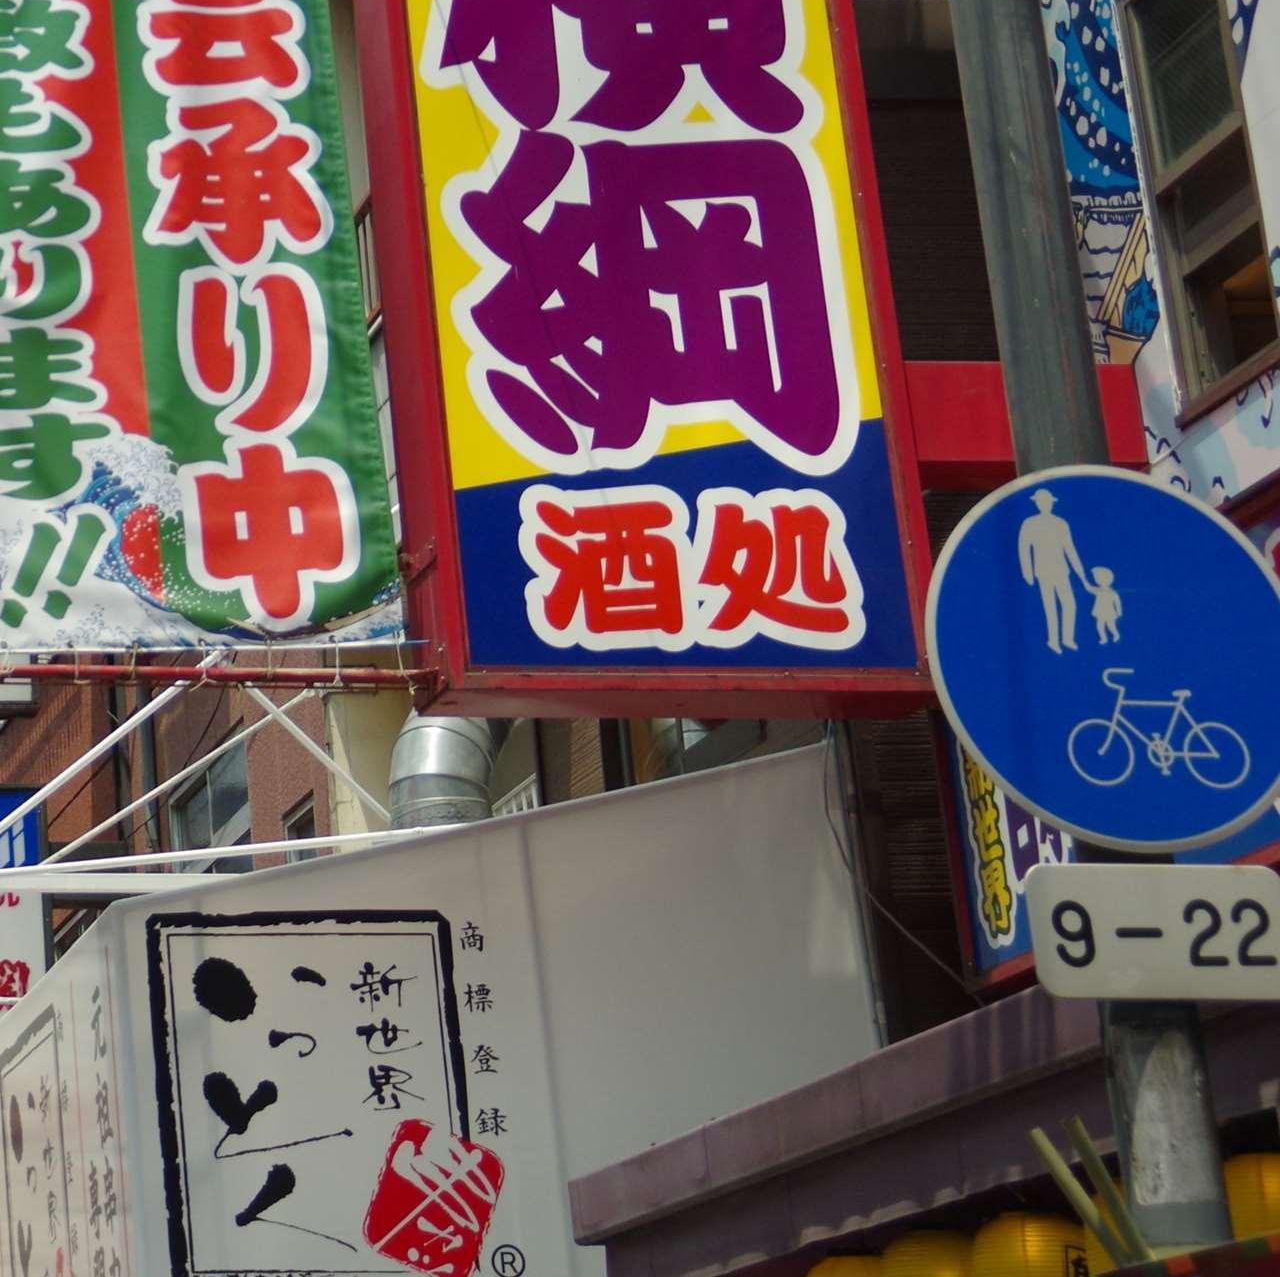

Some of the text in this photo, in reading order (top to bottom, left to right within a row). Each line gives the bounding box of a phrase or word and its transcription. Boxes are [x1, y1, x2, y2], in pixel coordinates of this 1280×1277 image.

[536, 500, 850, 634] 酒処
[351, 961, 425, 1113] 新世界
[460, 922, 509, 1137] 商標登録
